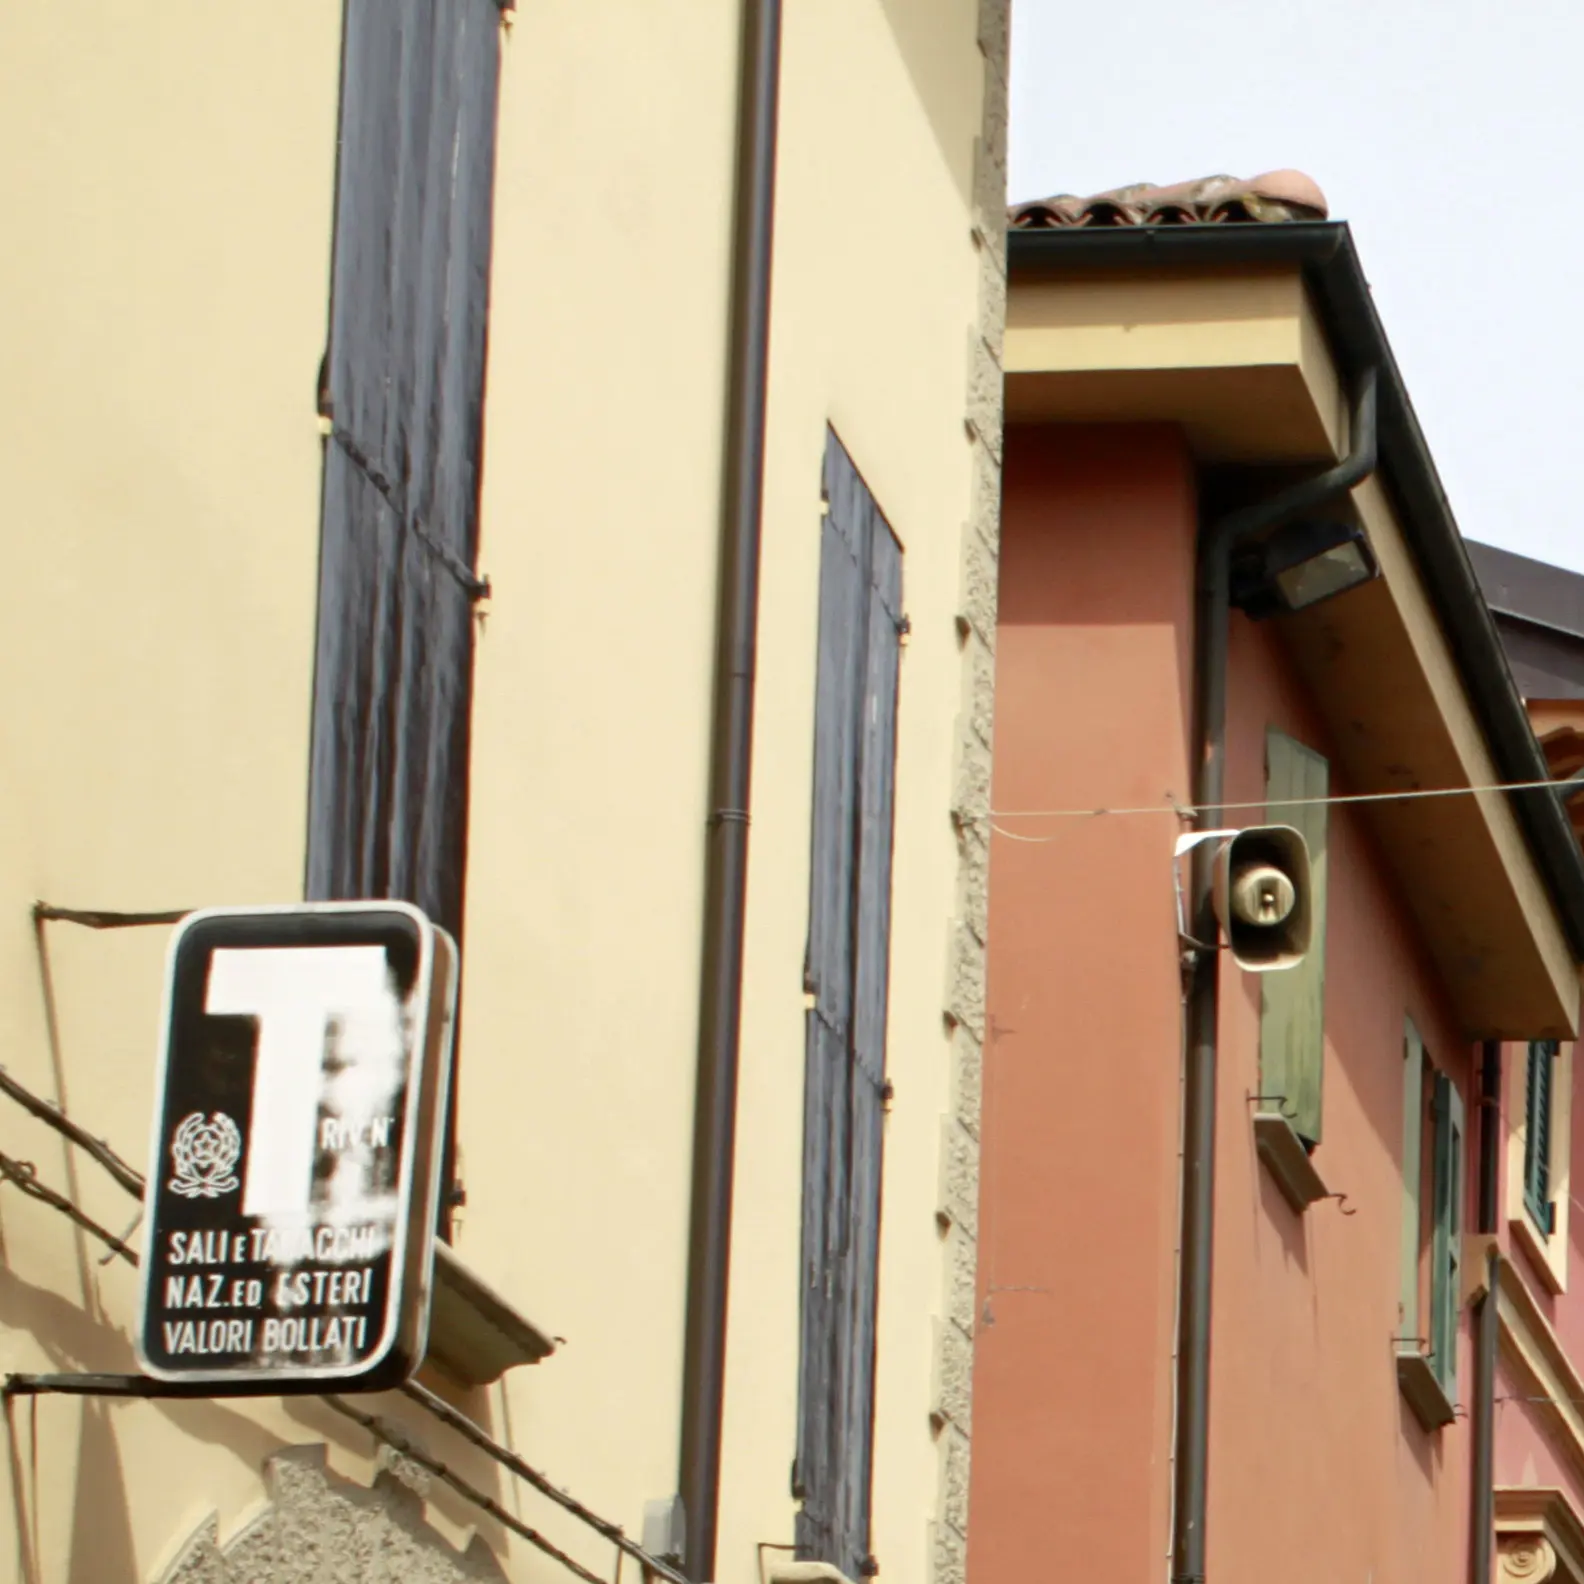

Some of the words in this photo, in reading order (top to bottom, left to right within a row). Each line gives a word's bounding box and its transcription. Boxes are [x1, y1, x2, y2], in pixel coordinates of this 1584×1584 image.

[204, 945, 388, 1218] T
[168, 1230, 229, 1264] SALI
[250, 1225, 376, 1262] TAACCHI
[274, 1268, 373, 1306] ESTERI
[164, 1320, 253, 1354] VALORI
[262, 1316, 367, 1351] BOLLATI
